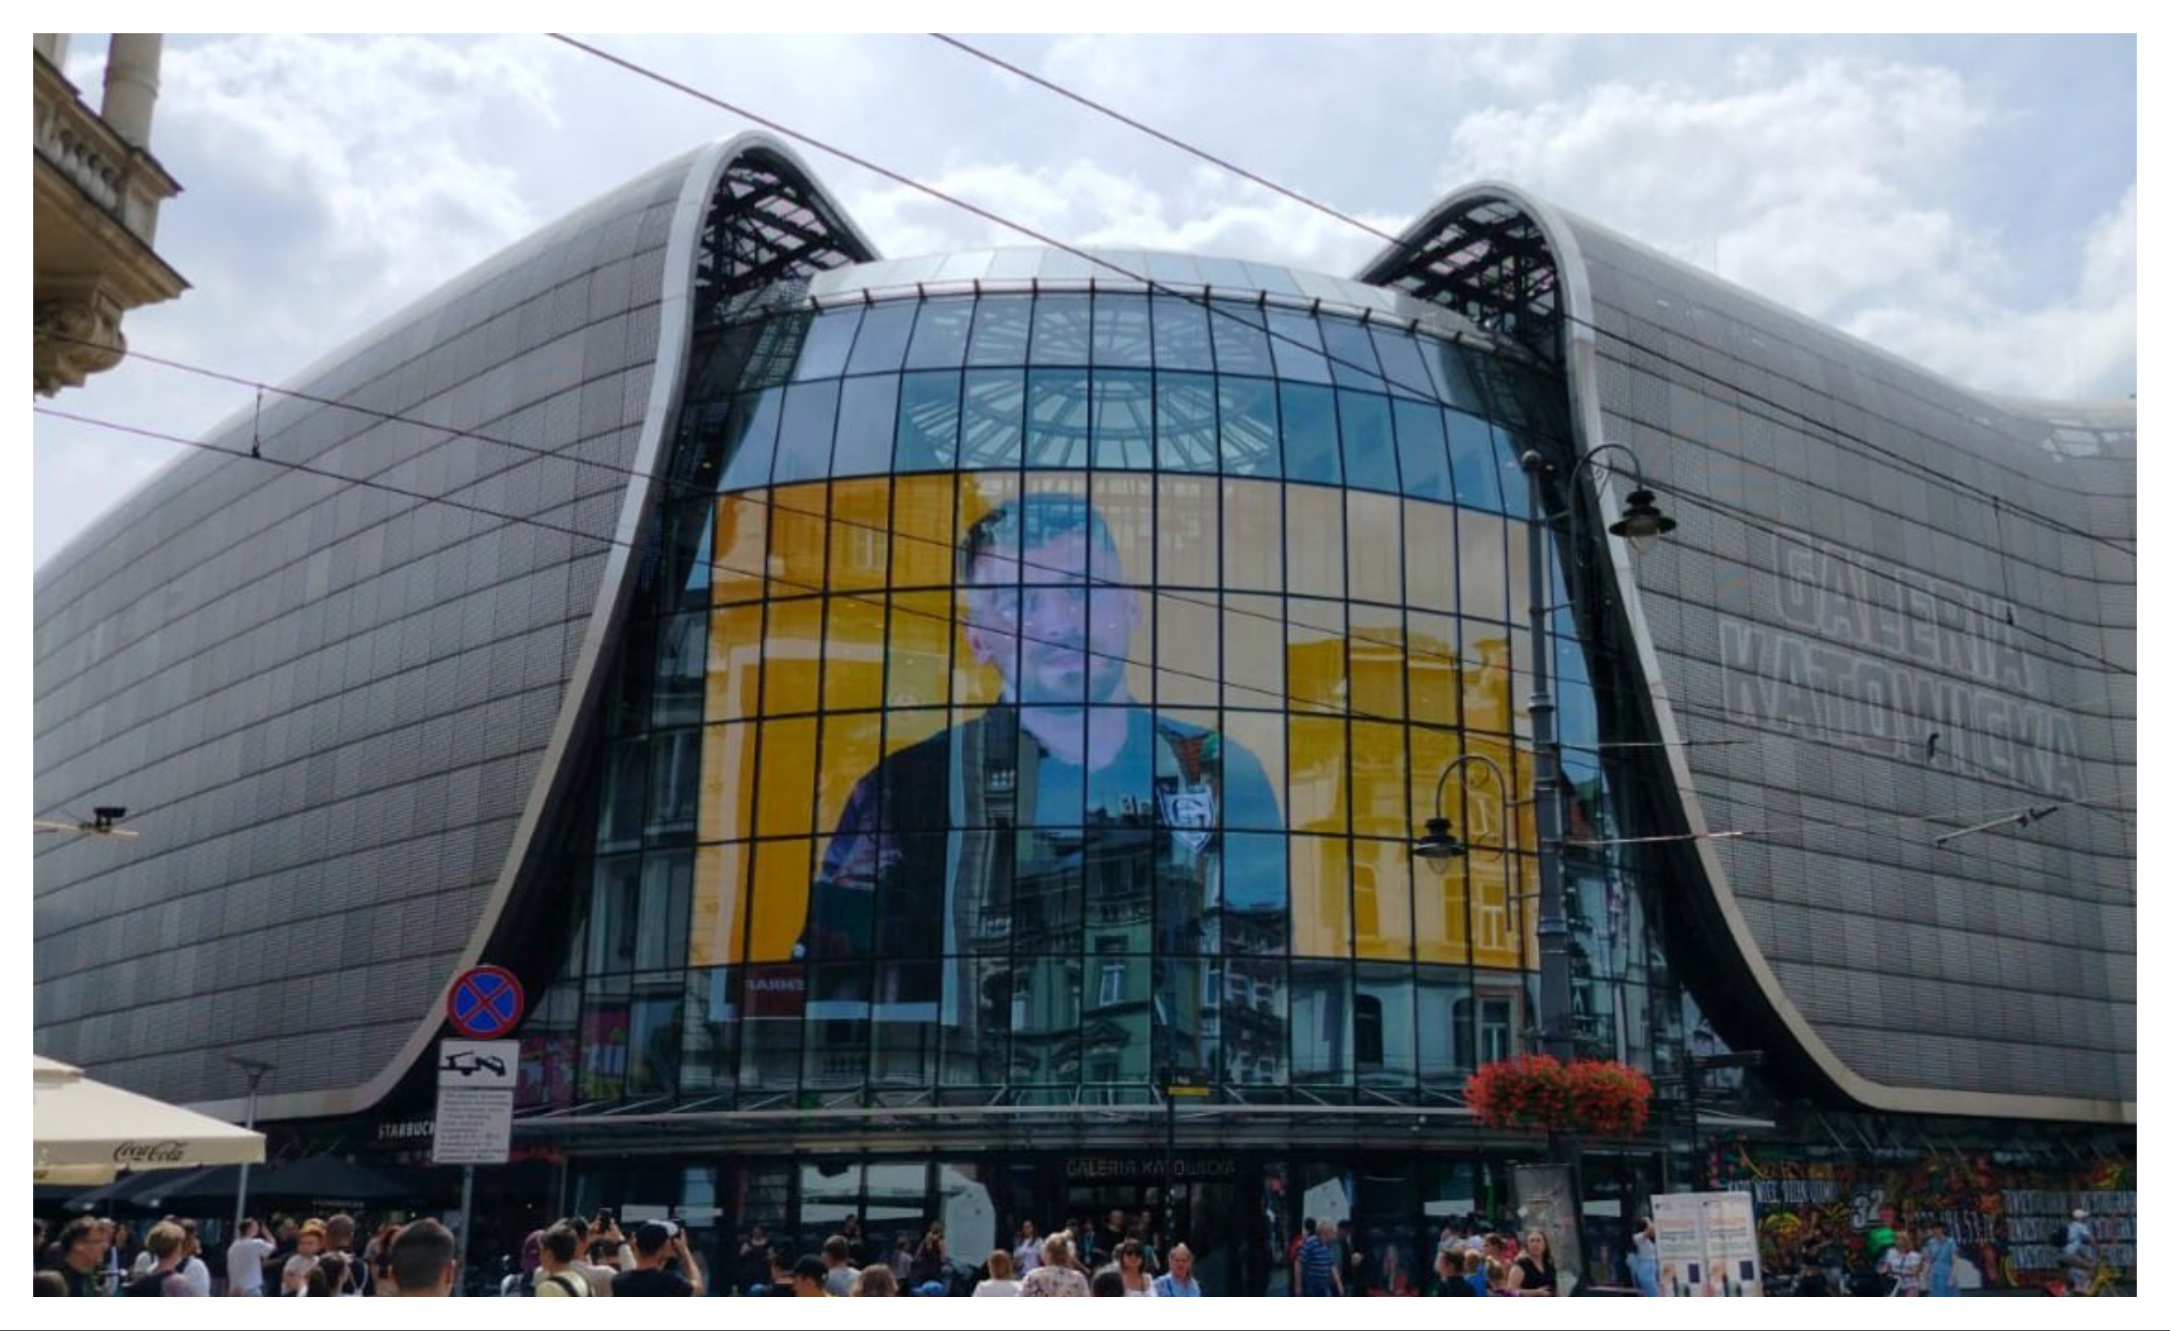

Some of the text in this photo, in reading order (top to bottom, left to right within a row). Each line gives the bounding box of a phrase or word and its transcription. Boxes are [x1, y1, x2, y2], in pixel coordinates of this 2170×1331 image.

[1773, 526, 2035, 694] GALERIA
[1718, 618, 2088, 800] KATOWICKA
[377, 1120, 436, 1140] STARBUCK
[1066, 1157, 1137, 1178] GALERIA
